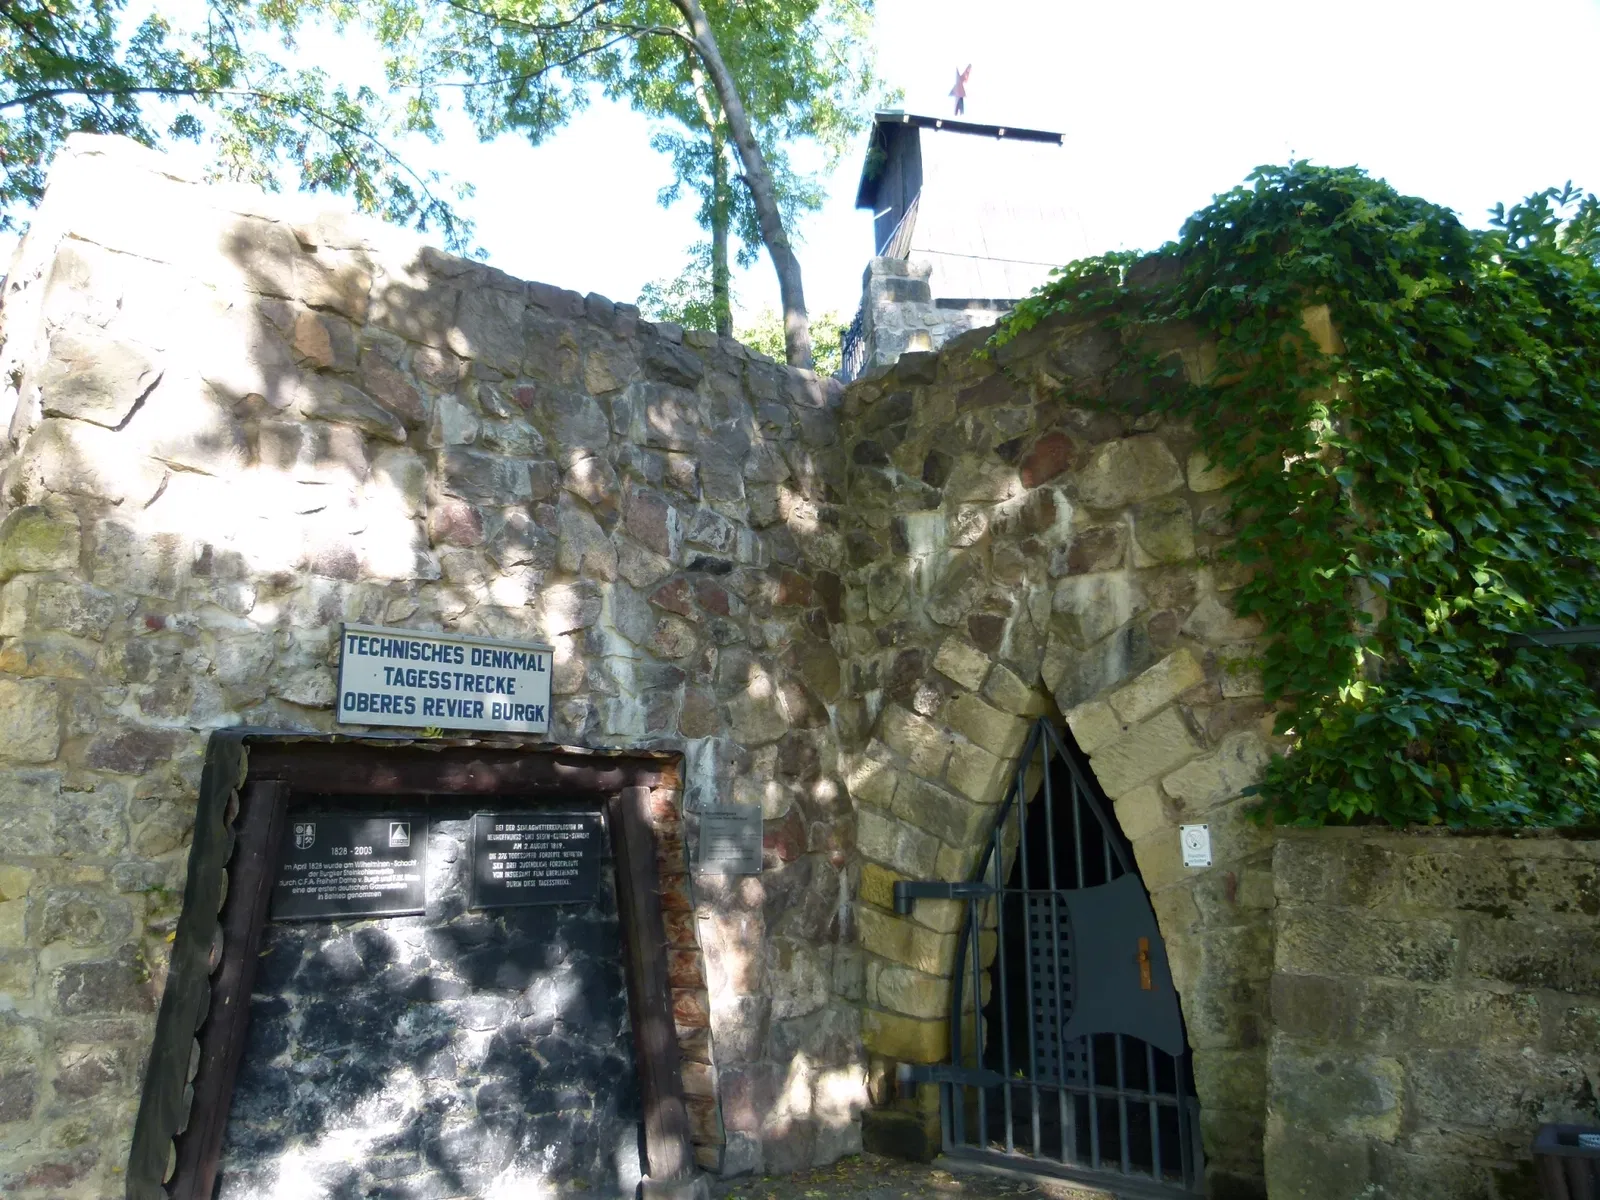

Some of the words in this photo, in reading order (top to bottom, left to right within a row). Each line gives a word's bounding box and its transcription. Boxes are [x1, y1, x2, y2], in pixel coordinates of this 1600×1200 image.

[346, 634, 465, 665] TECHNISCHES
[471, 647, 546, 673] DENKMAL
[383, 666, 516, 695] TAGESSTRECKE
[343, 691, 416, 715] OBERES
[422, 697, 484, 719] REVIER
[491, 701, 545, 722] BURGK
[331, 847, 348, 856] 1828
[354, 846, 373, 856] 2003
[513, 842, 523, 850] AM
[293, 863, 307, 871] April
